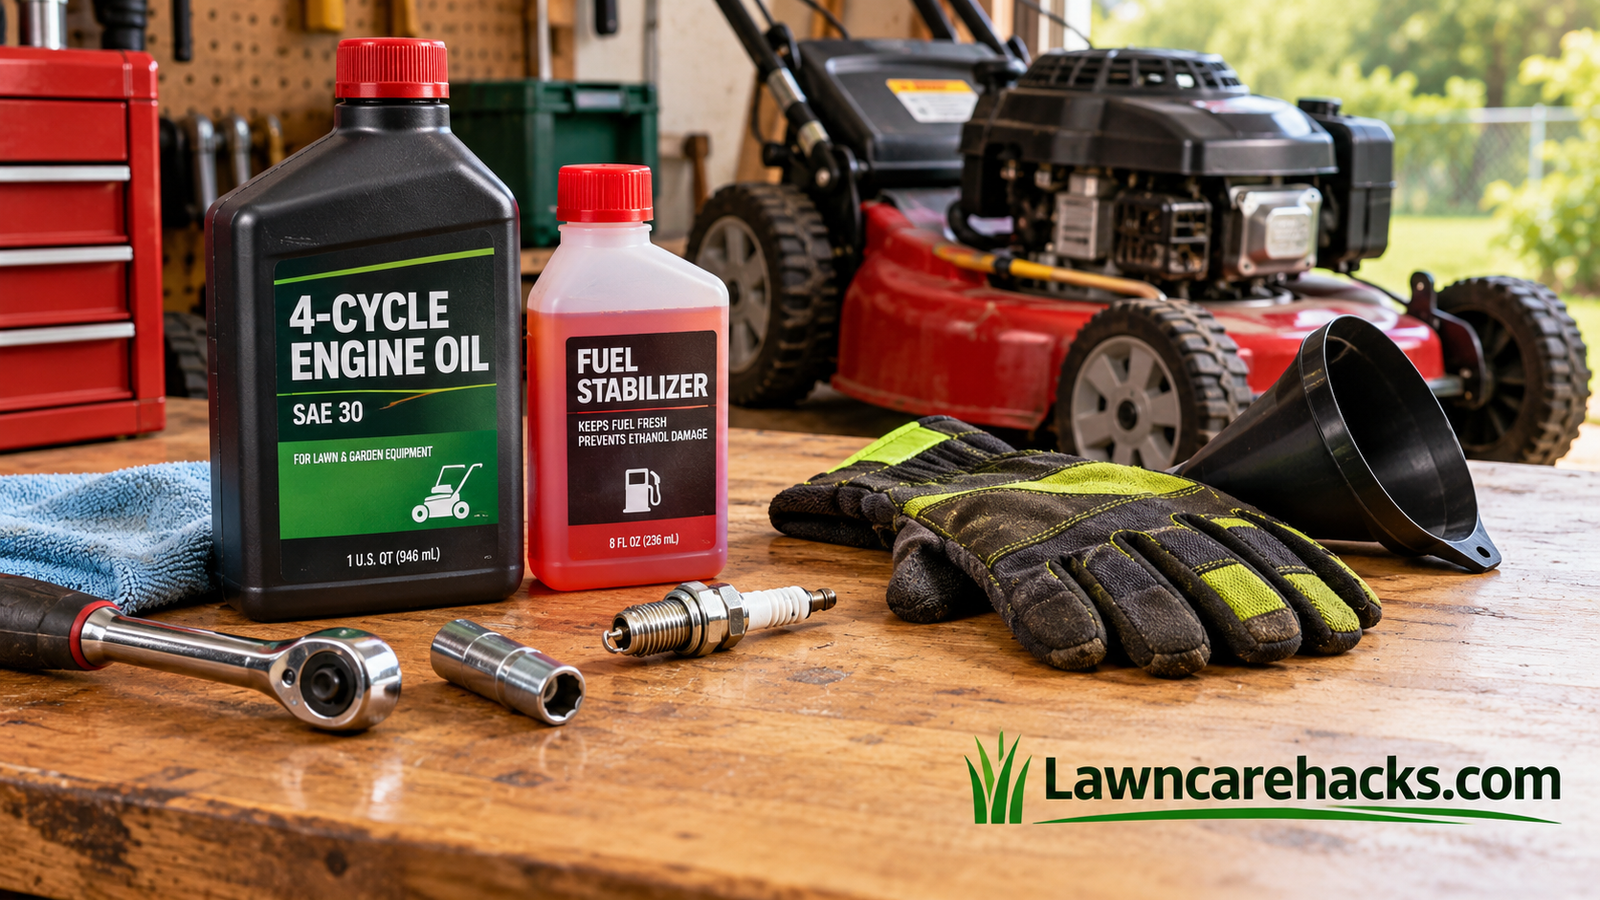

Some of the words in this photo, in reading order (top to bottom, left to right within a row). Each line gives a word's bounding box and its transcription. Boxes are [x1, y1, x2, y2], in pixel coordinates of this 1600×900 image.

[290, 291, 449, 334] 4-CYCLE
[292, 338, 425, 380] ENGINE
[435, 335, 489, 373] OIL
[577, 346, 639, 374] FUEL
[577, 373, 709, 404] STABILIZER
[293, 403, 332, 425] SAE
[339, 401, 363, 422] 30
[578, 419, 609, 433] KEEPS
[611, 418, 635, 431] FUEL
[637, 416, 667, 429] FRESH
[578, 433, 627, 447] PREVENTS
[628, 431, 670, 445] ETHANOL
[671, 427, 708, 442] DAMAGE
[293, 452, 311, 465] FOR
[313, 451, 339, 464] LAWN
[340, 451, 348, 463] &
[349, 448, 384, 462] GARDEN
[385, 445, 433, 462] EQUIPMENT
[609, 537, 616, 549] 8
[617, 536, 628, 549] FL
[629, 535, 641, 548] OZ
[642, 534, 662, 548] (236
[663, 532, 680, 546] mL)
[346, 554, 353, 568] 1
[355, 552, 377, 567] U.S.
[379, 550, 394, 566] QT
[395, 548, 419, 566] (946
[421, 546, 441, 562] mL)
